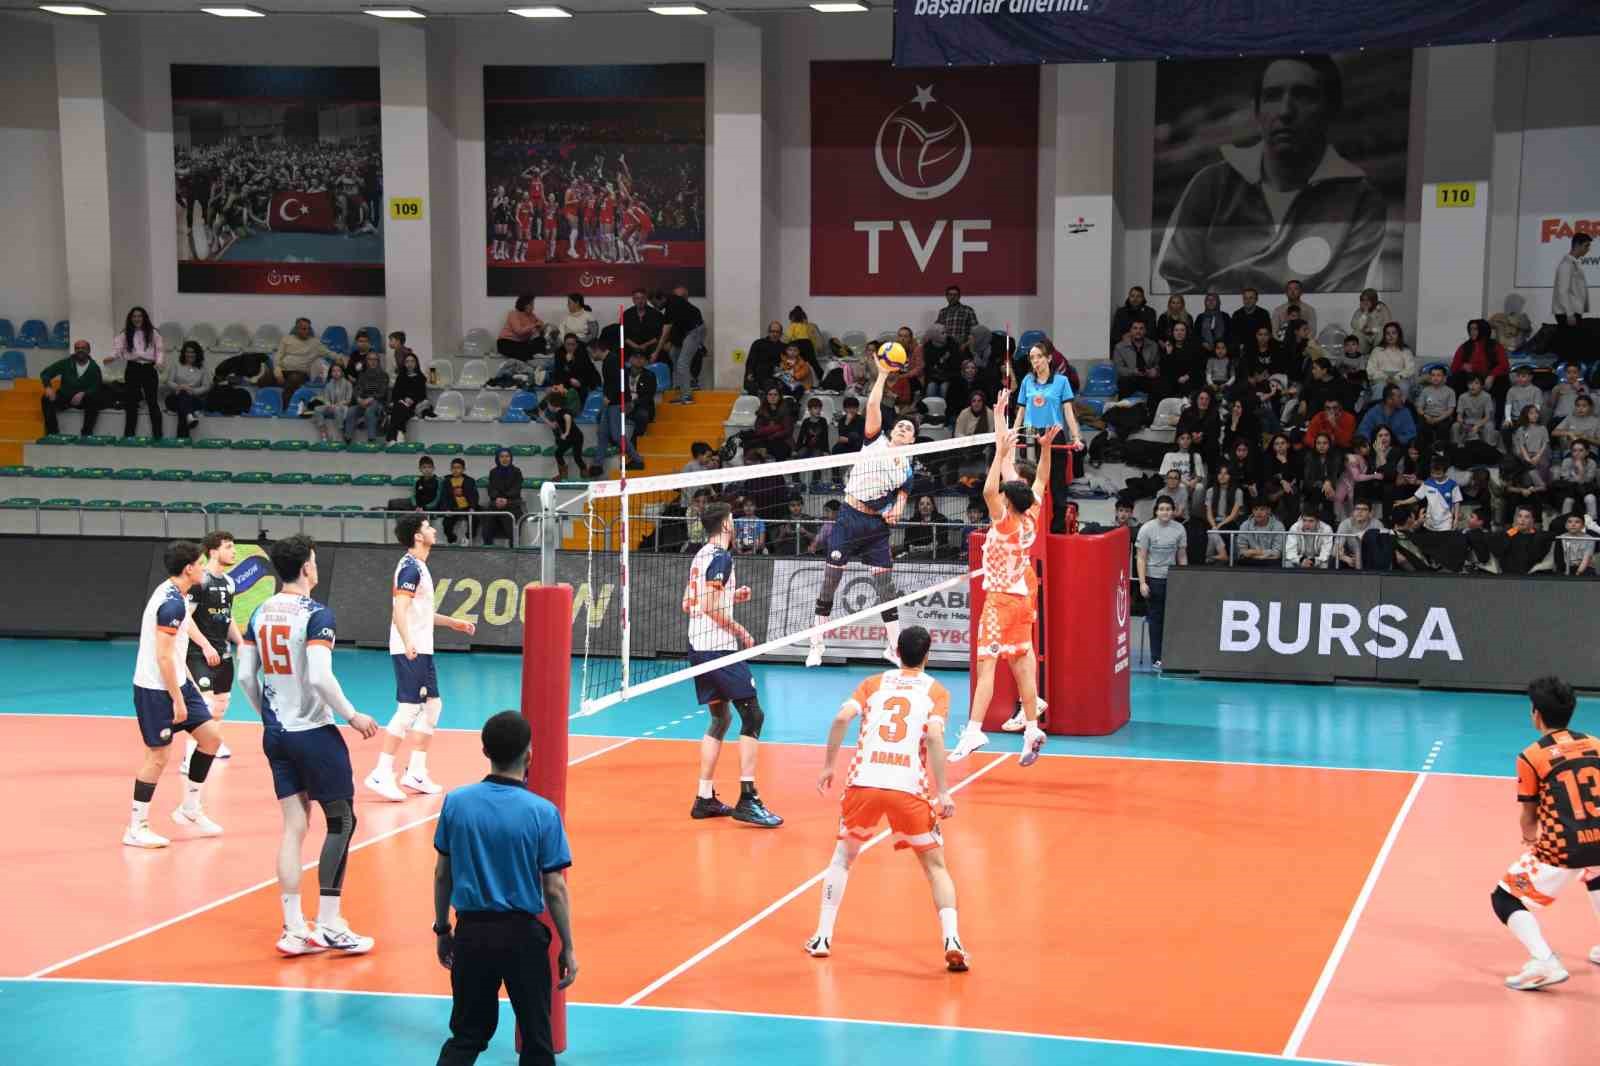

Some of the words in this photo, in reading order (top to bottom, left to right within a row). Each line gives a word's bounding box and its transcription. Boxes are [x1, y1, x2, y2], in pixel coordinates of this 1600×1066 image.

[393, 203, 419, 216] 109
[1442, 189, 1470, 203] 110
[854, 219, 992, 274] TVF
[282, 274, 301, 284] TVF
[595, 275, 616, 286] TVF
[1219, 600, 1464, 661] BURSA
[258, 623, 293, 676] 15
[879, 696, 912, 743] 3
[870, 750, 912, 768] ADANA
[1556, 766, 1600, 821] 13
